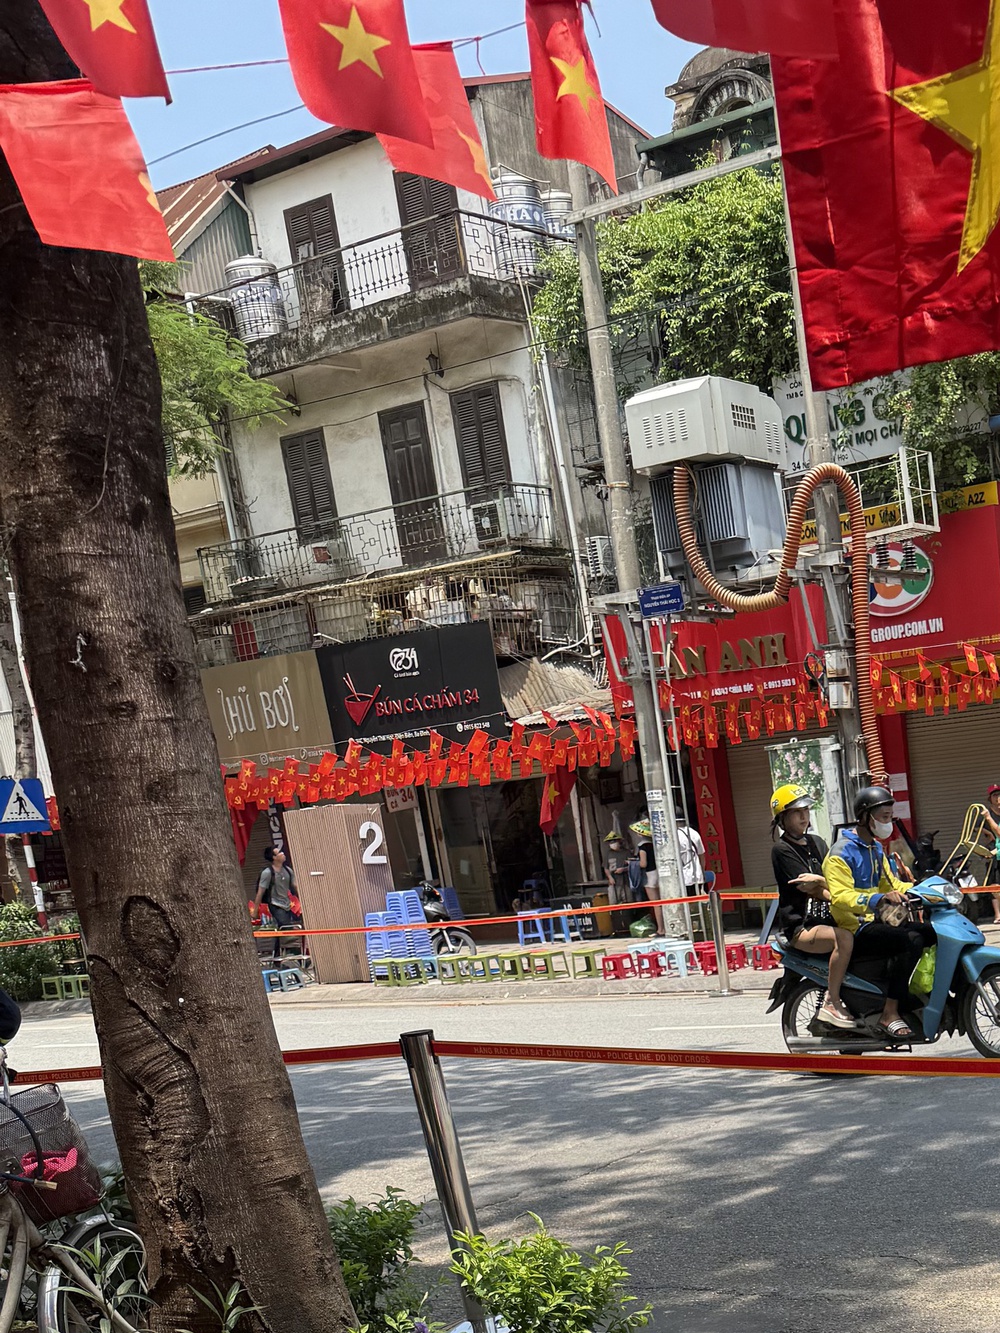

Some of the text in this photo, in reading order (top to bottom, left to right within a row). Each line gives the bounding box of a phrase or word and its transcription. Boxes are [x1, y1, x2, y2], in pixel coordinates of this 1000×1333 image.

[967, 492, 986, 506] A2Z
[718, 632, 789, 674] ANH
[374, 685, 480, 717] BÚN CÁ CHẤM 34
[401, 788, 415, 803] 34
[359, 821, 388, 865] 2
